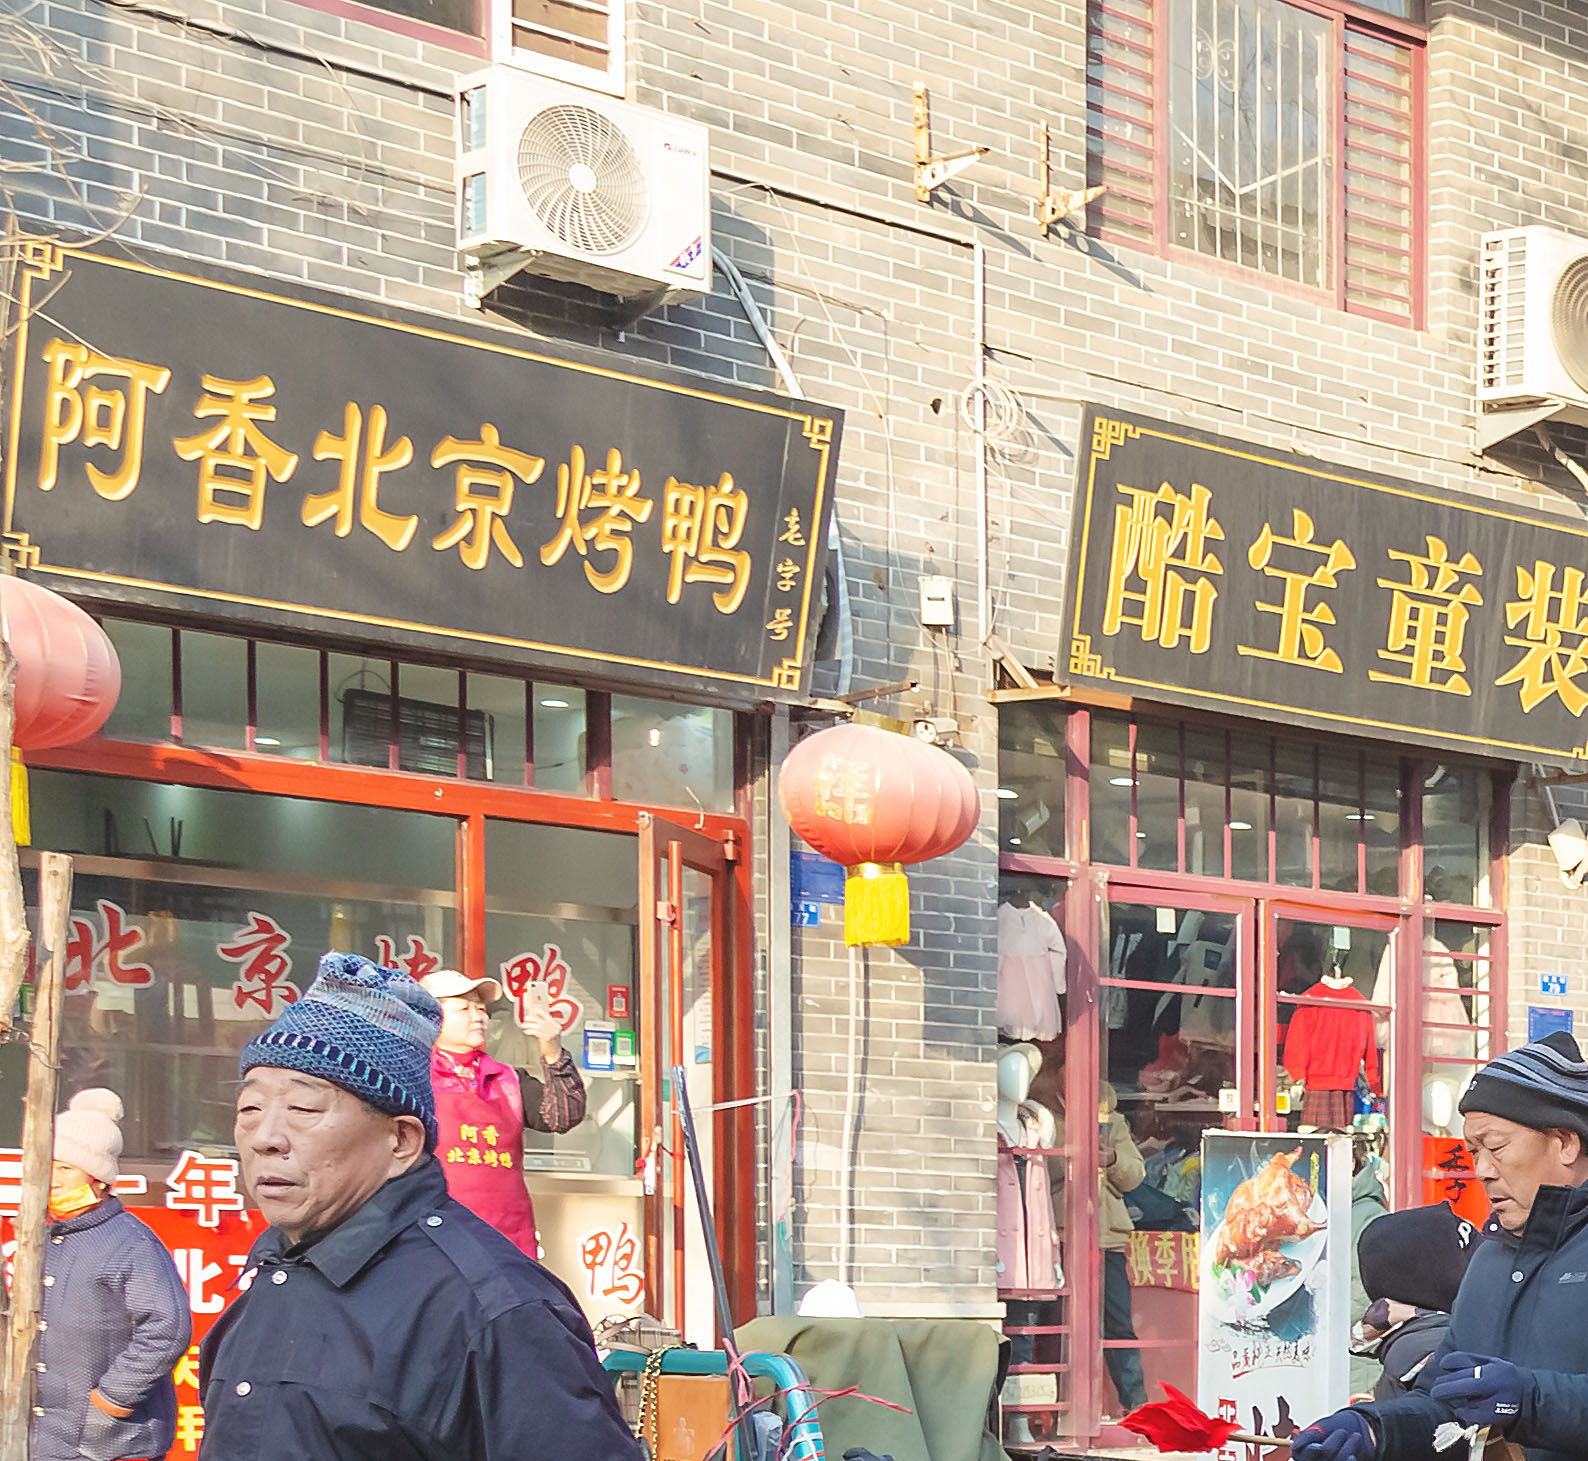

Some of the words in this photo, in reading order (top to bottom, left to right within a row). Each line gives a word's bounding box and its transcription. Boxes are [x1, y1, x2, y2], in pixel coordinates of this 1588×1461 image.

[39, 337, 752, 616] 阿香北京烤鸭
[764, 506, 806, 643] 老字号
[459, 1124, 500, 1146] 阿香
